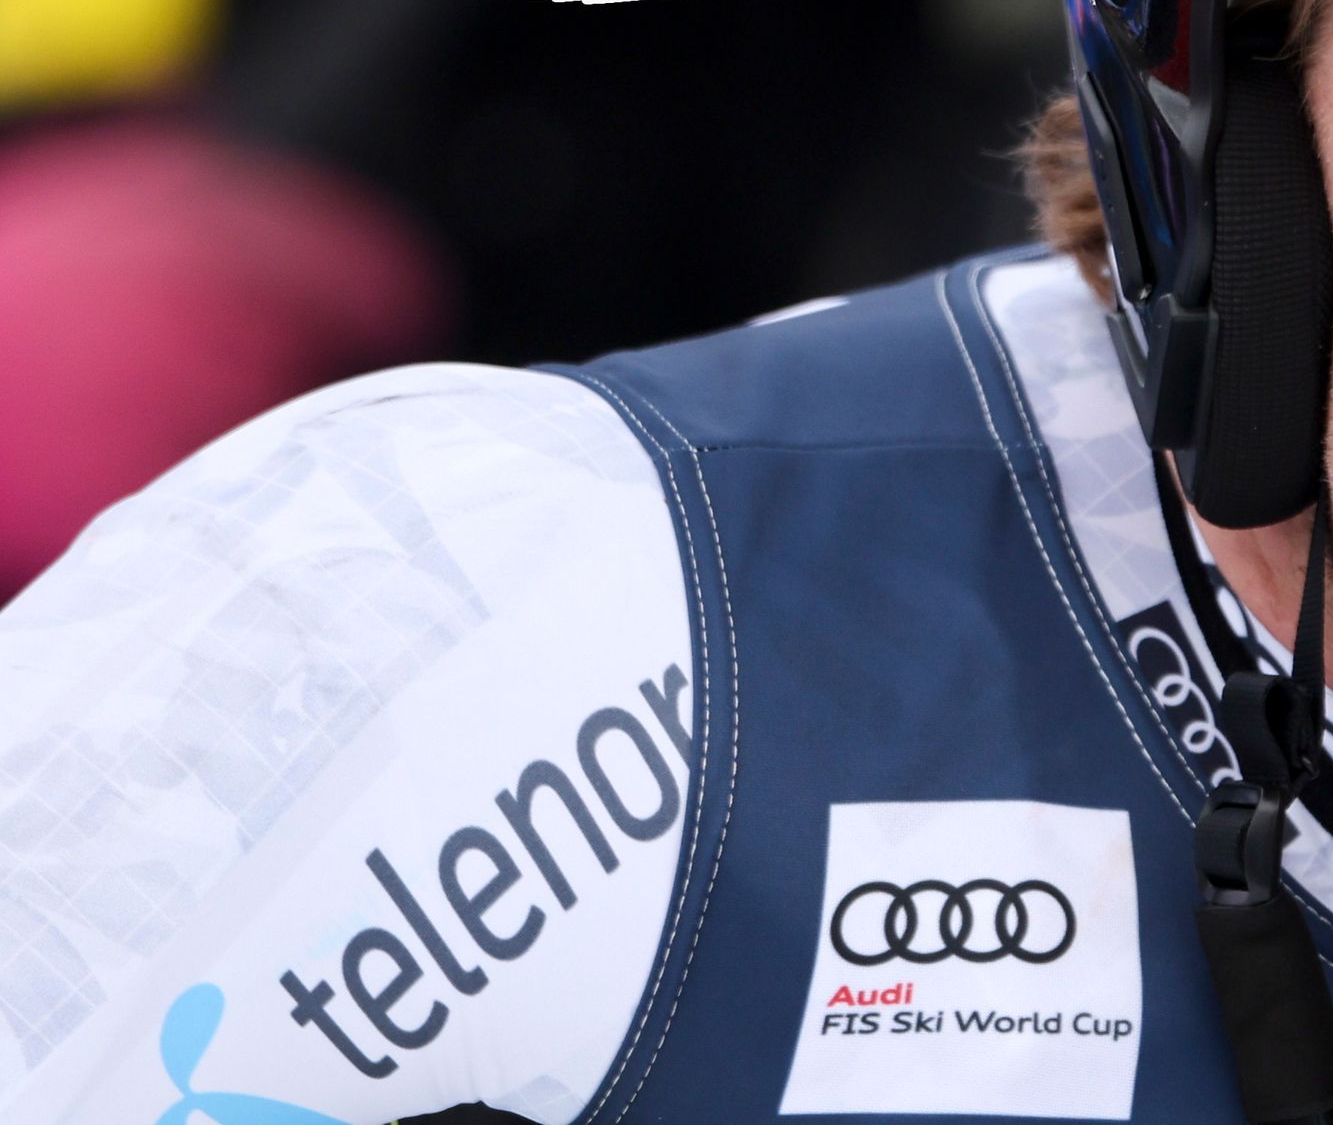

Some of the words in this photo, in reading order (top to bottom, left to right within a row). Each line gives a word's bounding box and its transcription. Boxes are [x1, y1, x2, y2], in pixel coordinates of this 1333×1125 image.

[279, 663, 691, 1079] telenor
[827, 983, 914, 1007] Audi
[821, 1012, 881, 1035] FIS
[890, 1011, 944, 1034] Ski
[954, 1011, 1062, 1033] World
[1072, 1013, 1133, 1041] Cup
